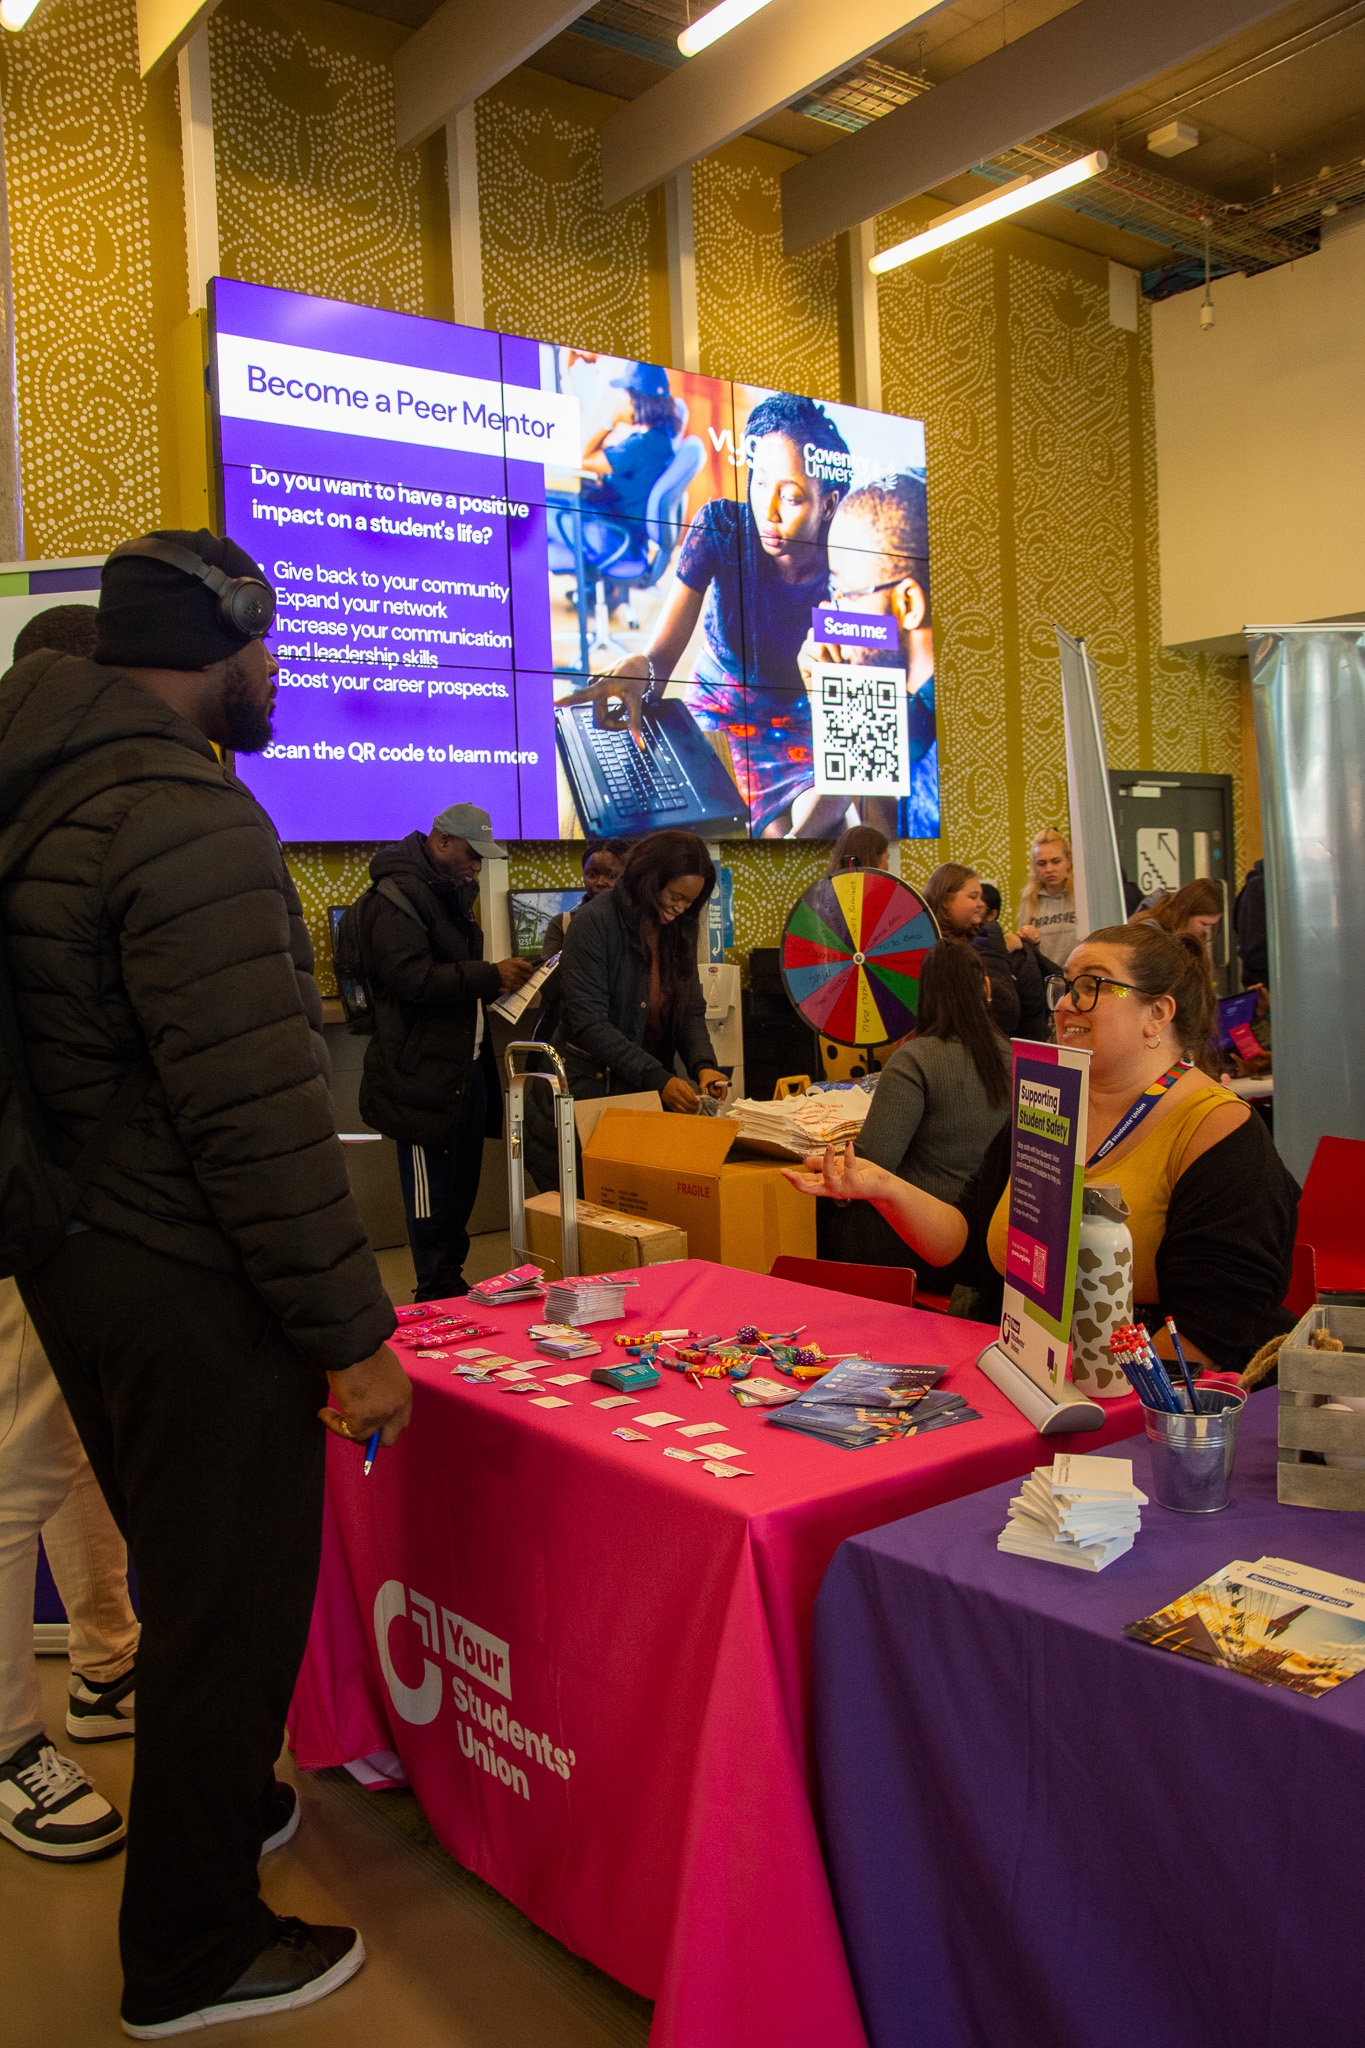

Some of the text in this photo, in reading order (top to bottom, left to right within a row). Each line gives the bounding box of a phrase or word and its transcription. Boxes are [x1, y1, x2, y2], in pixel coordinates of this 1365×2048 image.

[248, 365, 555, 439] Become a Peer Mentor
[251, 464, 529, 518] Do you want to have a positive
[252, 499, 493, 545] impact on a student's life?
[274, 561, 510, 603] Give back to your community
[275, 588, 339, 613] Expand
[342, 596, 380, 614] your
[383, 597, 448, 619] network
[276, 614, 512, 649] Increase your communication
[824, 617, 887, 640] Scan me:
[278, 642, 438, 670] and leadership skills
[278, 669, 509, 699] Boost your career prospects.
[262, 742, 538, 764] Scan the QR code to learn more
[1142, 872, 1152, 891] G
[1029, 912, 1076, 928] THRASHE
[1021, 1085, 1058, 1115] Supporting
[1019, 1109, 1068, 1144] Student Safety
[1112, 1117, 1133, 1142] Students'
[1131, 1103, 1147, 1119] Union
[677, 1183, 710, 1198] FRAGILE
[874, 1367, 936, 1375] SafeZone
[1250, 1574, 1349, 1608] Spirituality and Faith
[446, 1616, 504, 1682] Your
[452, 1676, 576, 1780] Students'
[456, 1720, 530, 1801] Union
